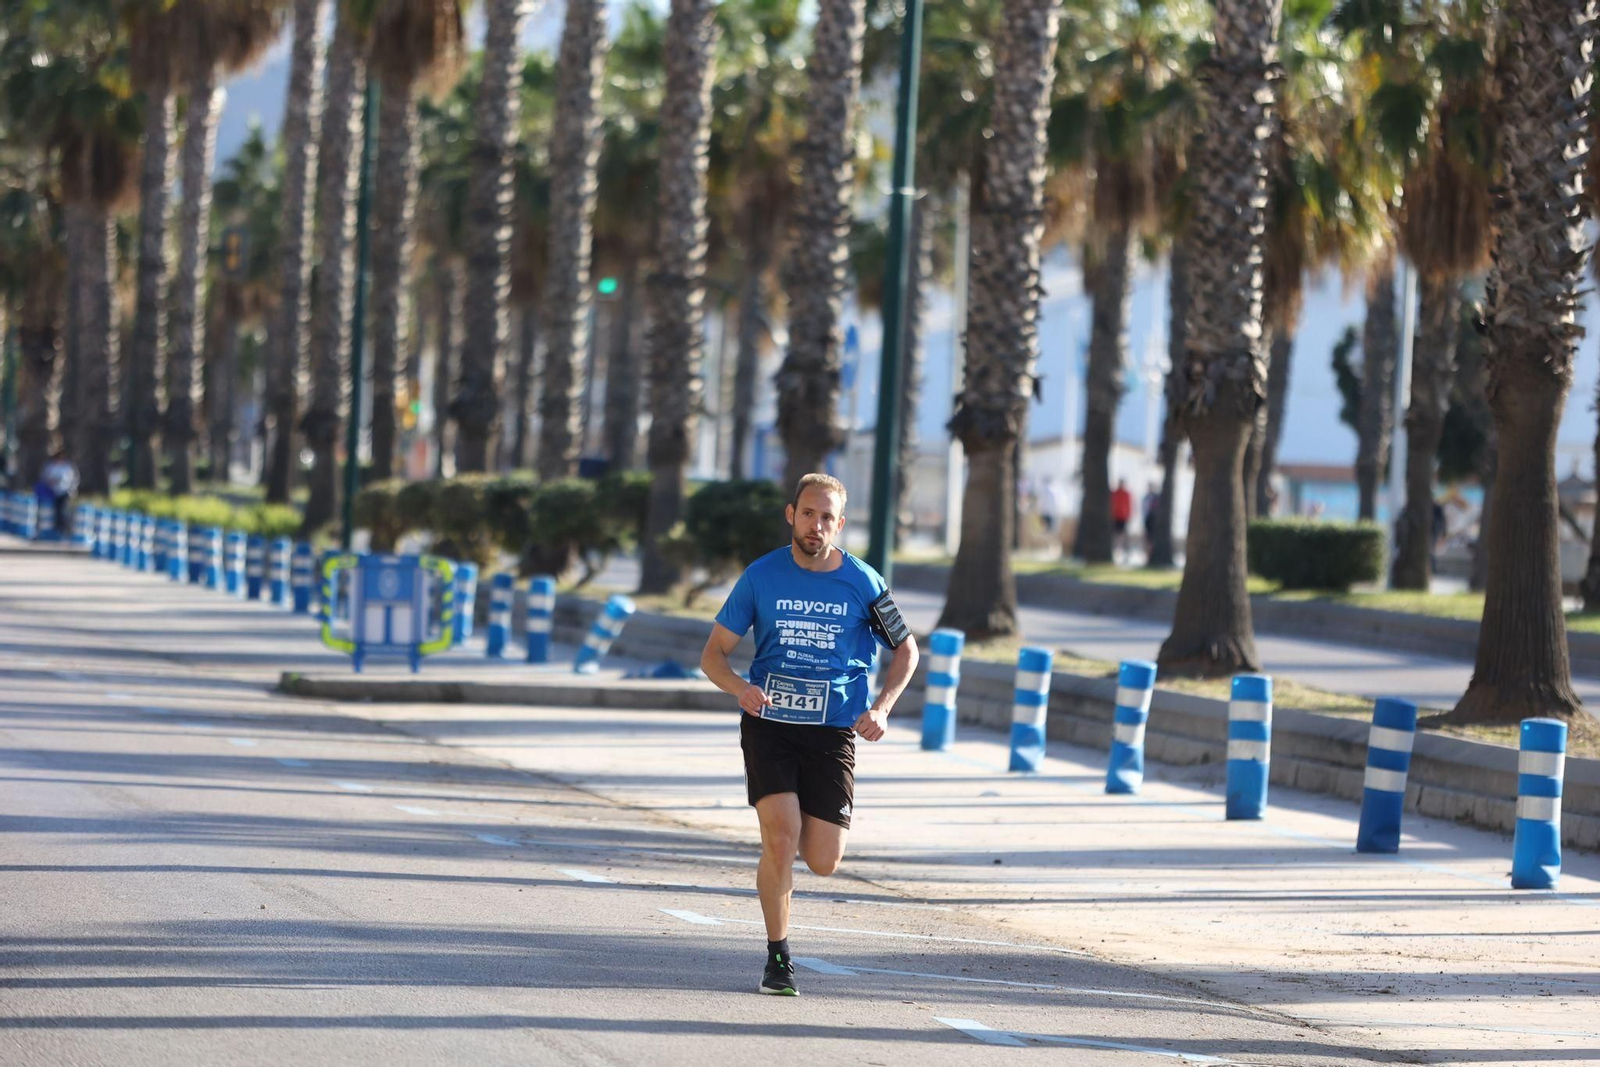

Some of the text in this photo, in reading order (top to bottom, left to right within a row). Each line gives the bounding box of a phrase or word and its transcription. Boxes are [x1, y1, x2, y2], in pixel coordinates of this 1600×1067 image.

[776, 599, 848, 616] mayoral
[775, 620, 842, 633] RUNNING
[781, 629, 836, 641] MAKES
[779, 637, 836, 650] FRIENDS
[771, 692, 818, 710] 2141
